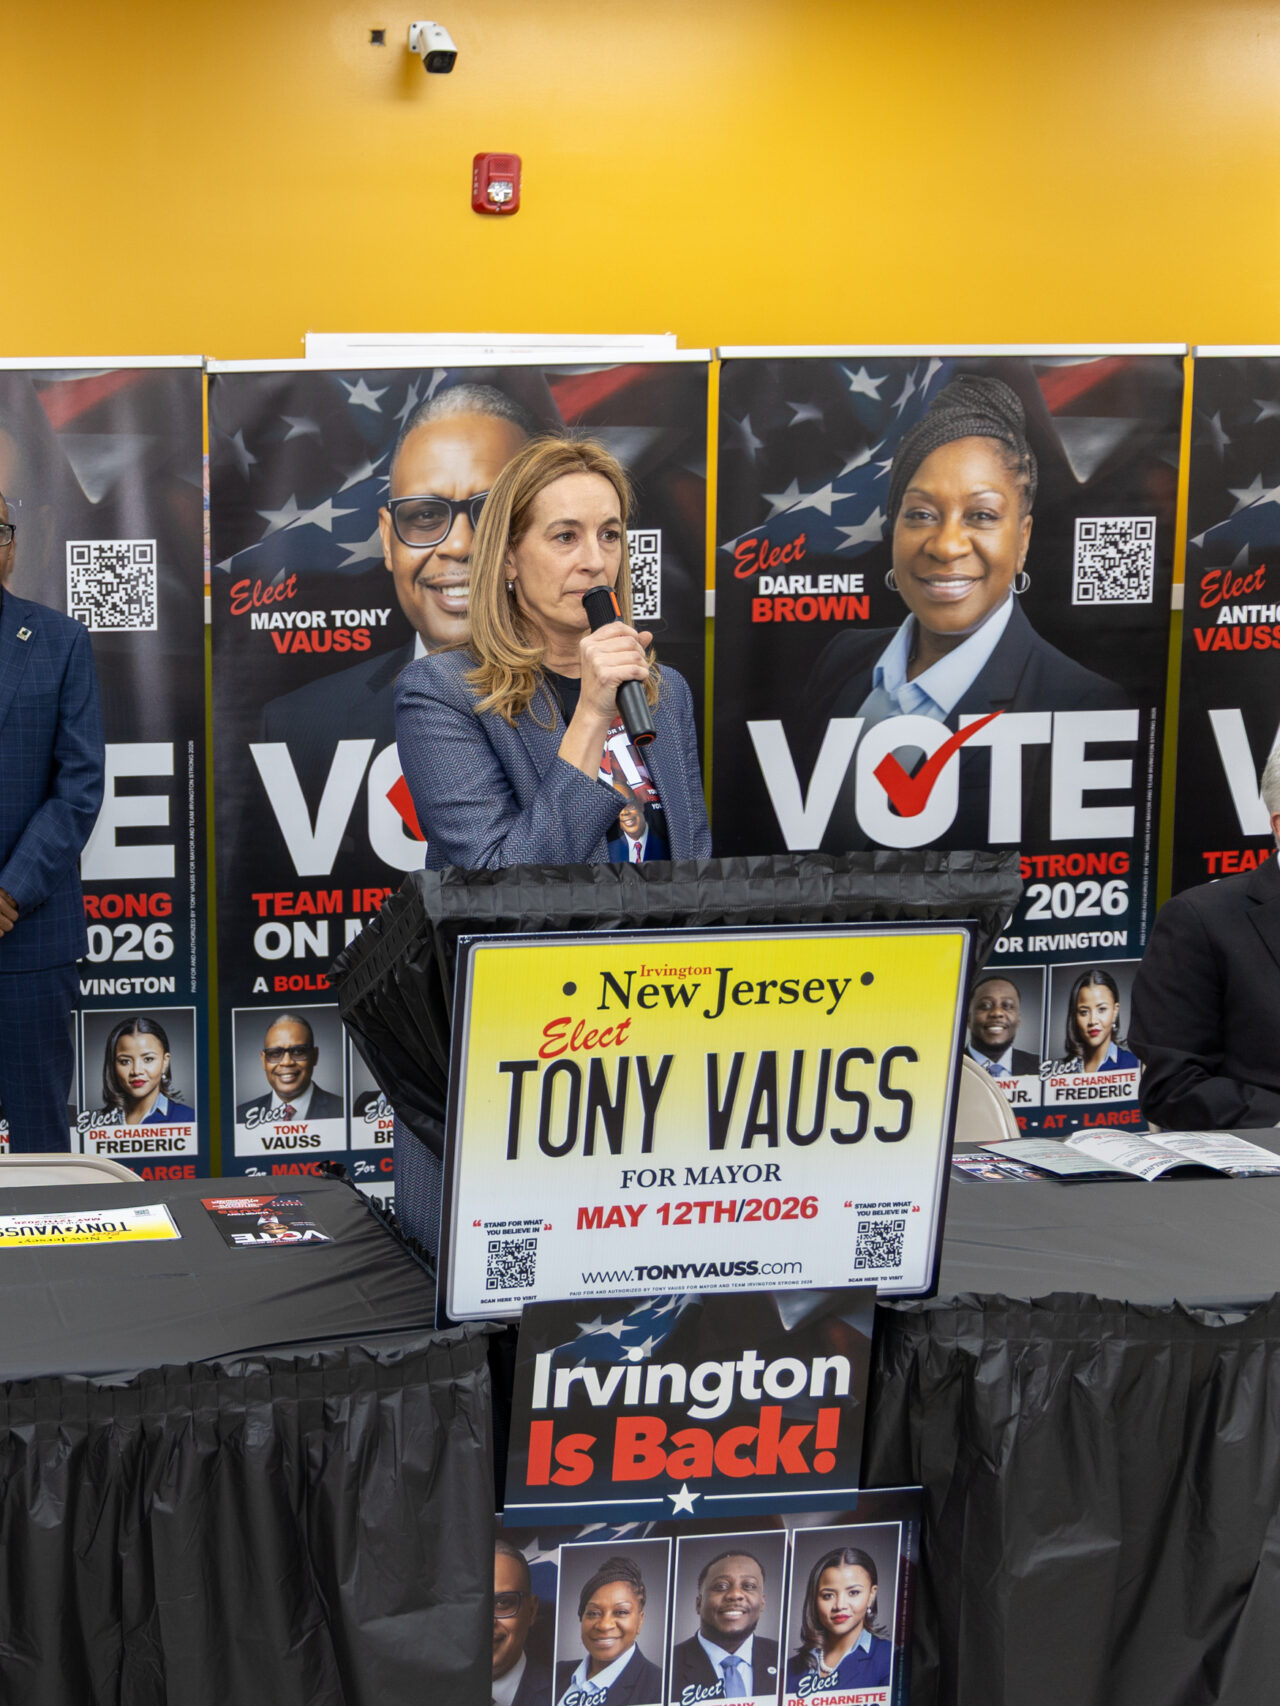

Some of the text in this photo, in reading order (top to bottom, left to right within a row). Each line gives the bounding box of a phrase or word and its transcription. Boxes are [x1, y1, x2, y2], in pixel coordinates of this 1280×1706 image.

[734, 533, 806, 579] Elect
[230, 573, 298, 616] Elect
[759, 573, 864, 595] DARLENE
[1200, 563, 1266, 609] Elect
[251, 608, 392, 630] MAYOR TONY
[751, 595, 870, 623] BROWN
[271, 628, 372, 654] VAUSS
[746, 709, 1140, 851] VOTE
[1020, 852, 1130, 880] STRONG
[83, 892, 173, 919] RONG
[252, 889, 343, 917] TEAM
[1024, 880, 1129, 921] 2026
[86, 922, 174, 963] 026
[253, 919, 329, 960] ON
[995, 930, 1128, 953] OR IRVINGTON
[252, 973, 331, 993] A BOLD
[639, 963, 713, 980] Irvington
[80, 976, 175, 996] VINGTON
[597, 967, 852, 1019] New Jersey
[538, 1016, 632, 1060] Elect
[1039, 1058, 1078, 1082] Elect
[1050, 1072, 1136, 1088] DR. CHARNETTE
[499, 1045, 919, 1160] TONY VAUSS
[1055, 1084, 1132, 1101] FREDERIC
[76, 1108, 120, 1134] Elect
[245, 1102, 286, 1130] Elect
[1042, 1114, 1067, 1129] AT
[1083, 1109, 1141, 1127] LARGE
[89, 1126, 192, 1140] DR. CHARNETTE
[273, 1124, 308, 1135] TONY
[95, 1138, 186, 1154] FREDERIC
[261, 1134, 321, 1150] VAUSS
[131, 1165, 196, 1181] ARGE
[354, 1161, 376, 1176] For
[620, 1163, 782, 1189] FOR MAYOR
[576, 1196, 819, 1230] MAY 12TH/2026
[75, 1221, 131, 1234] TONY
[231, 1229, 330, 1244] VOTE
[502, 1227, 531, 1235] BELIEVE
[582, 1260, 802, 1284] www.TONYVAUSS.com
[532, 1346, 851, 1419] Irvington
[526, 1405, 841, 1486] Is Back!
[681, 1680, 723, 1705] Elect
[798, 1673, 840, 1697] Elect
[812, 1692, 887, 1706] CHARNETTE
